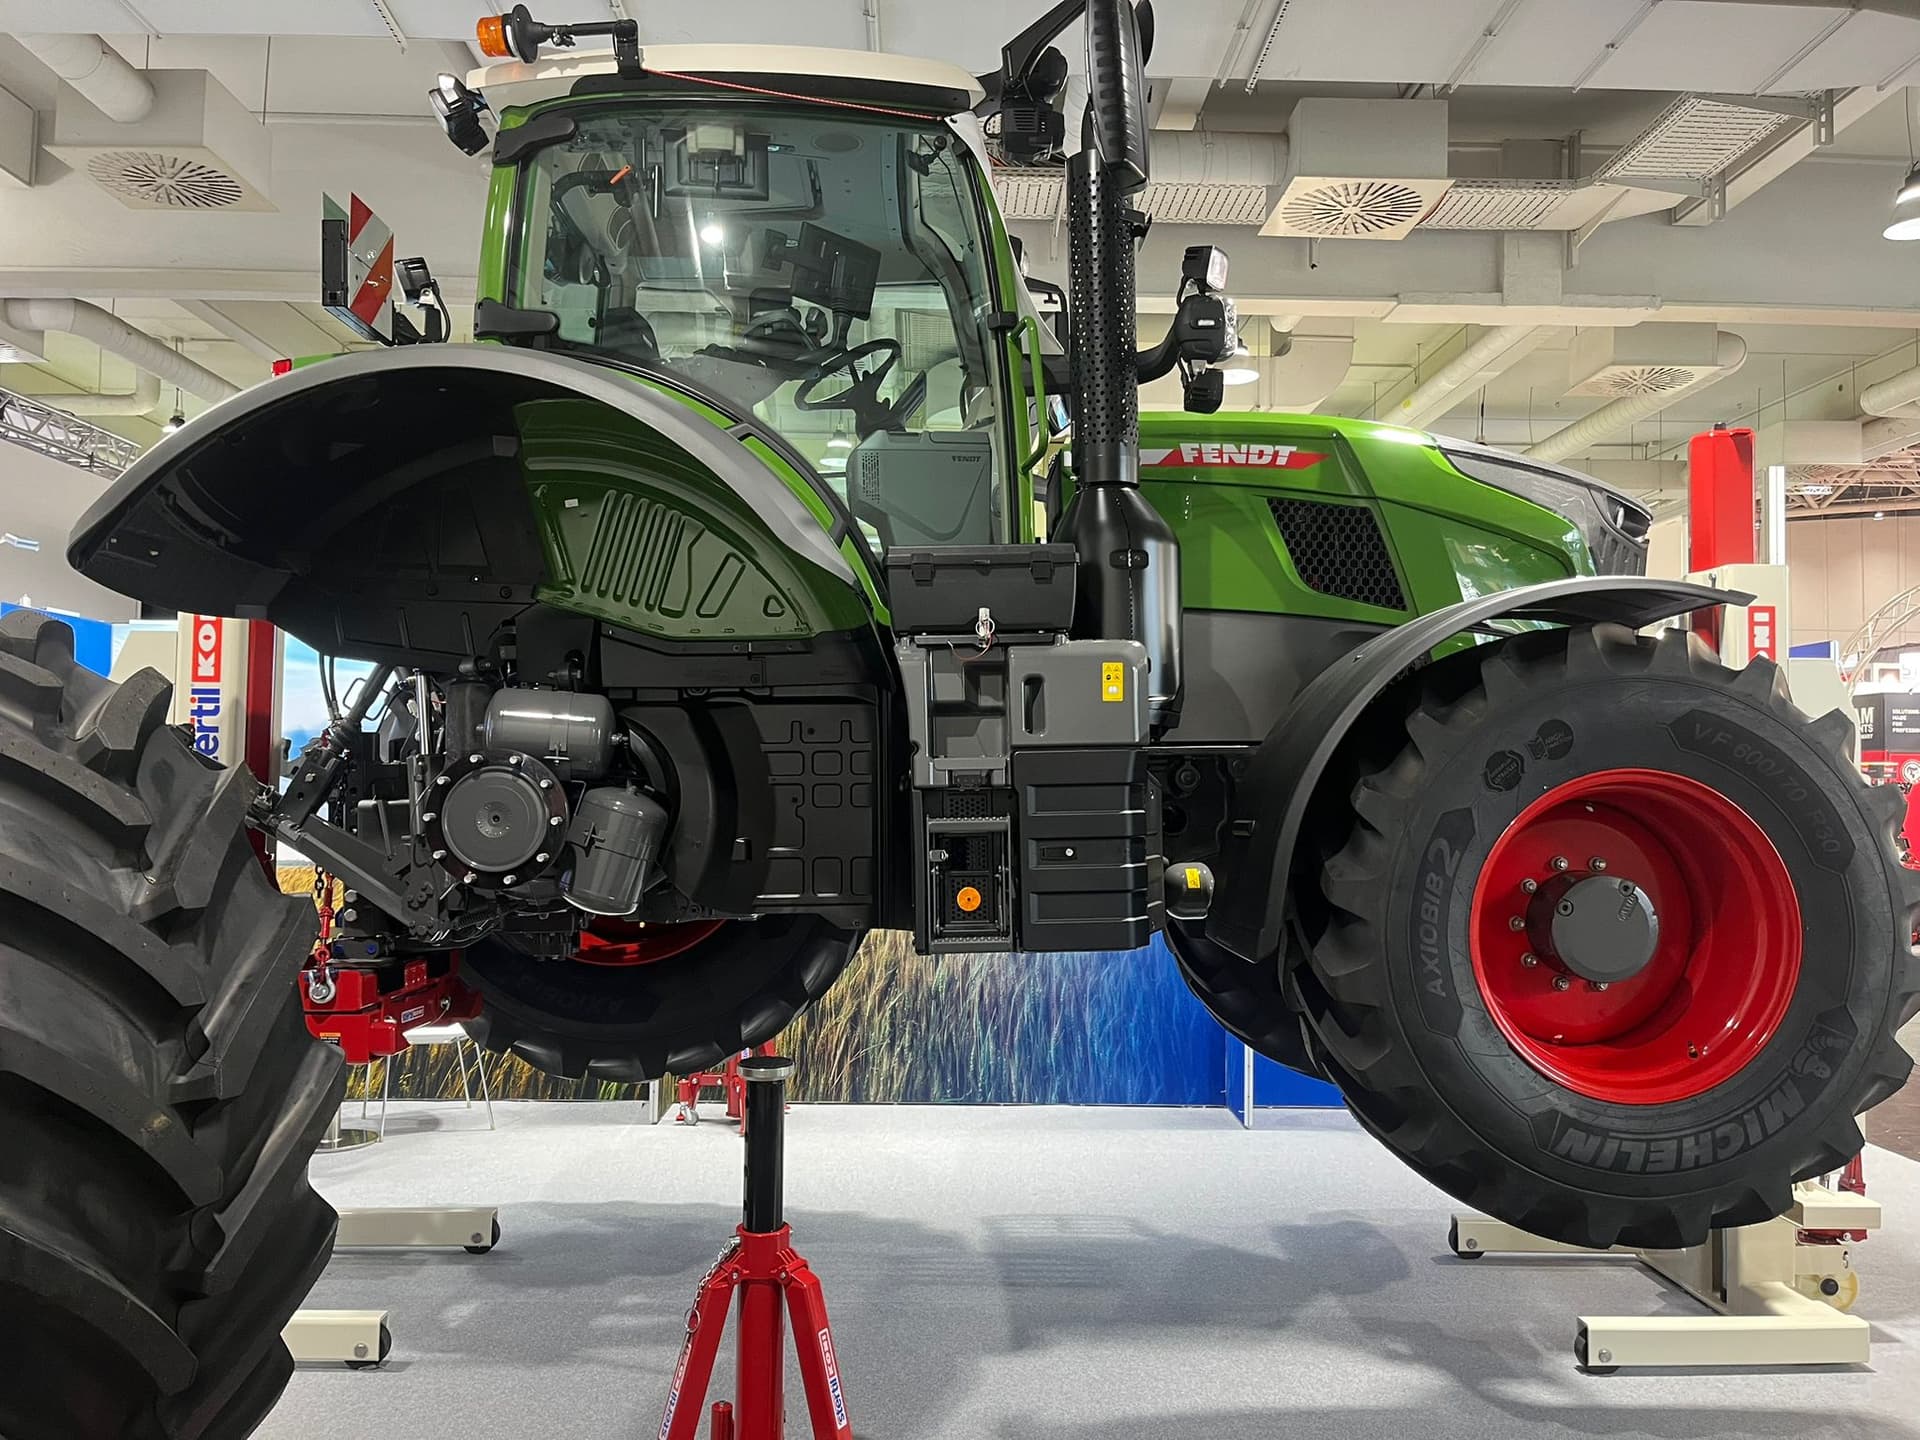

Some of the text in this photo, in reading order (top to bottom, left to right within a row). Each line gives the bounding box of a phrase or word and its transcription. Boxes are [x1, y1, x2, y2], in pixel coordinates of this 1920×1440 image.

[1180, 443, 1297, 466] FENDT
[190, 614, 221, 761] ertil KO
[1419, 838, 1461, 998] AXIOBIB 2
[1556, 1077, 1807, 1173] MICHELIN
[821, 1334, 847, 1425] stertil KONI
